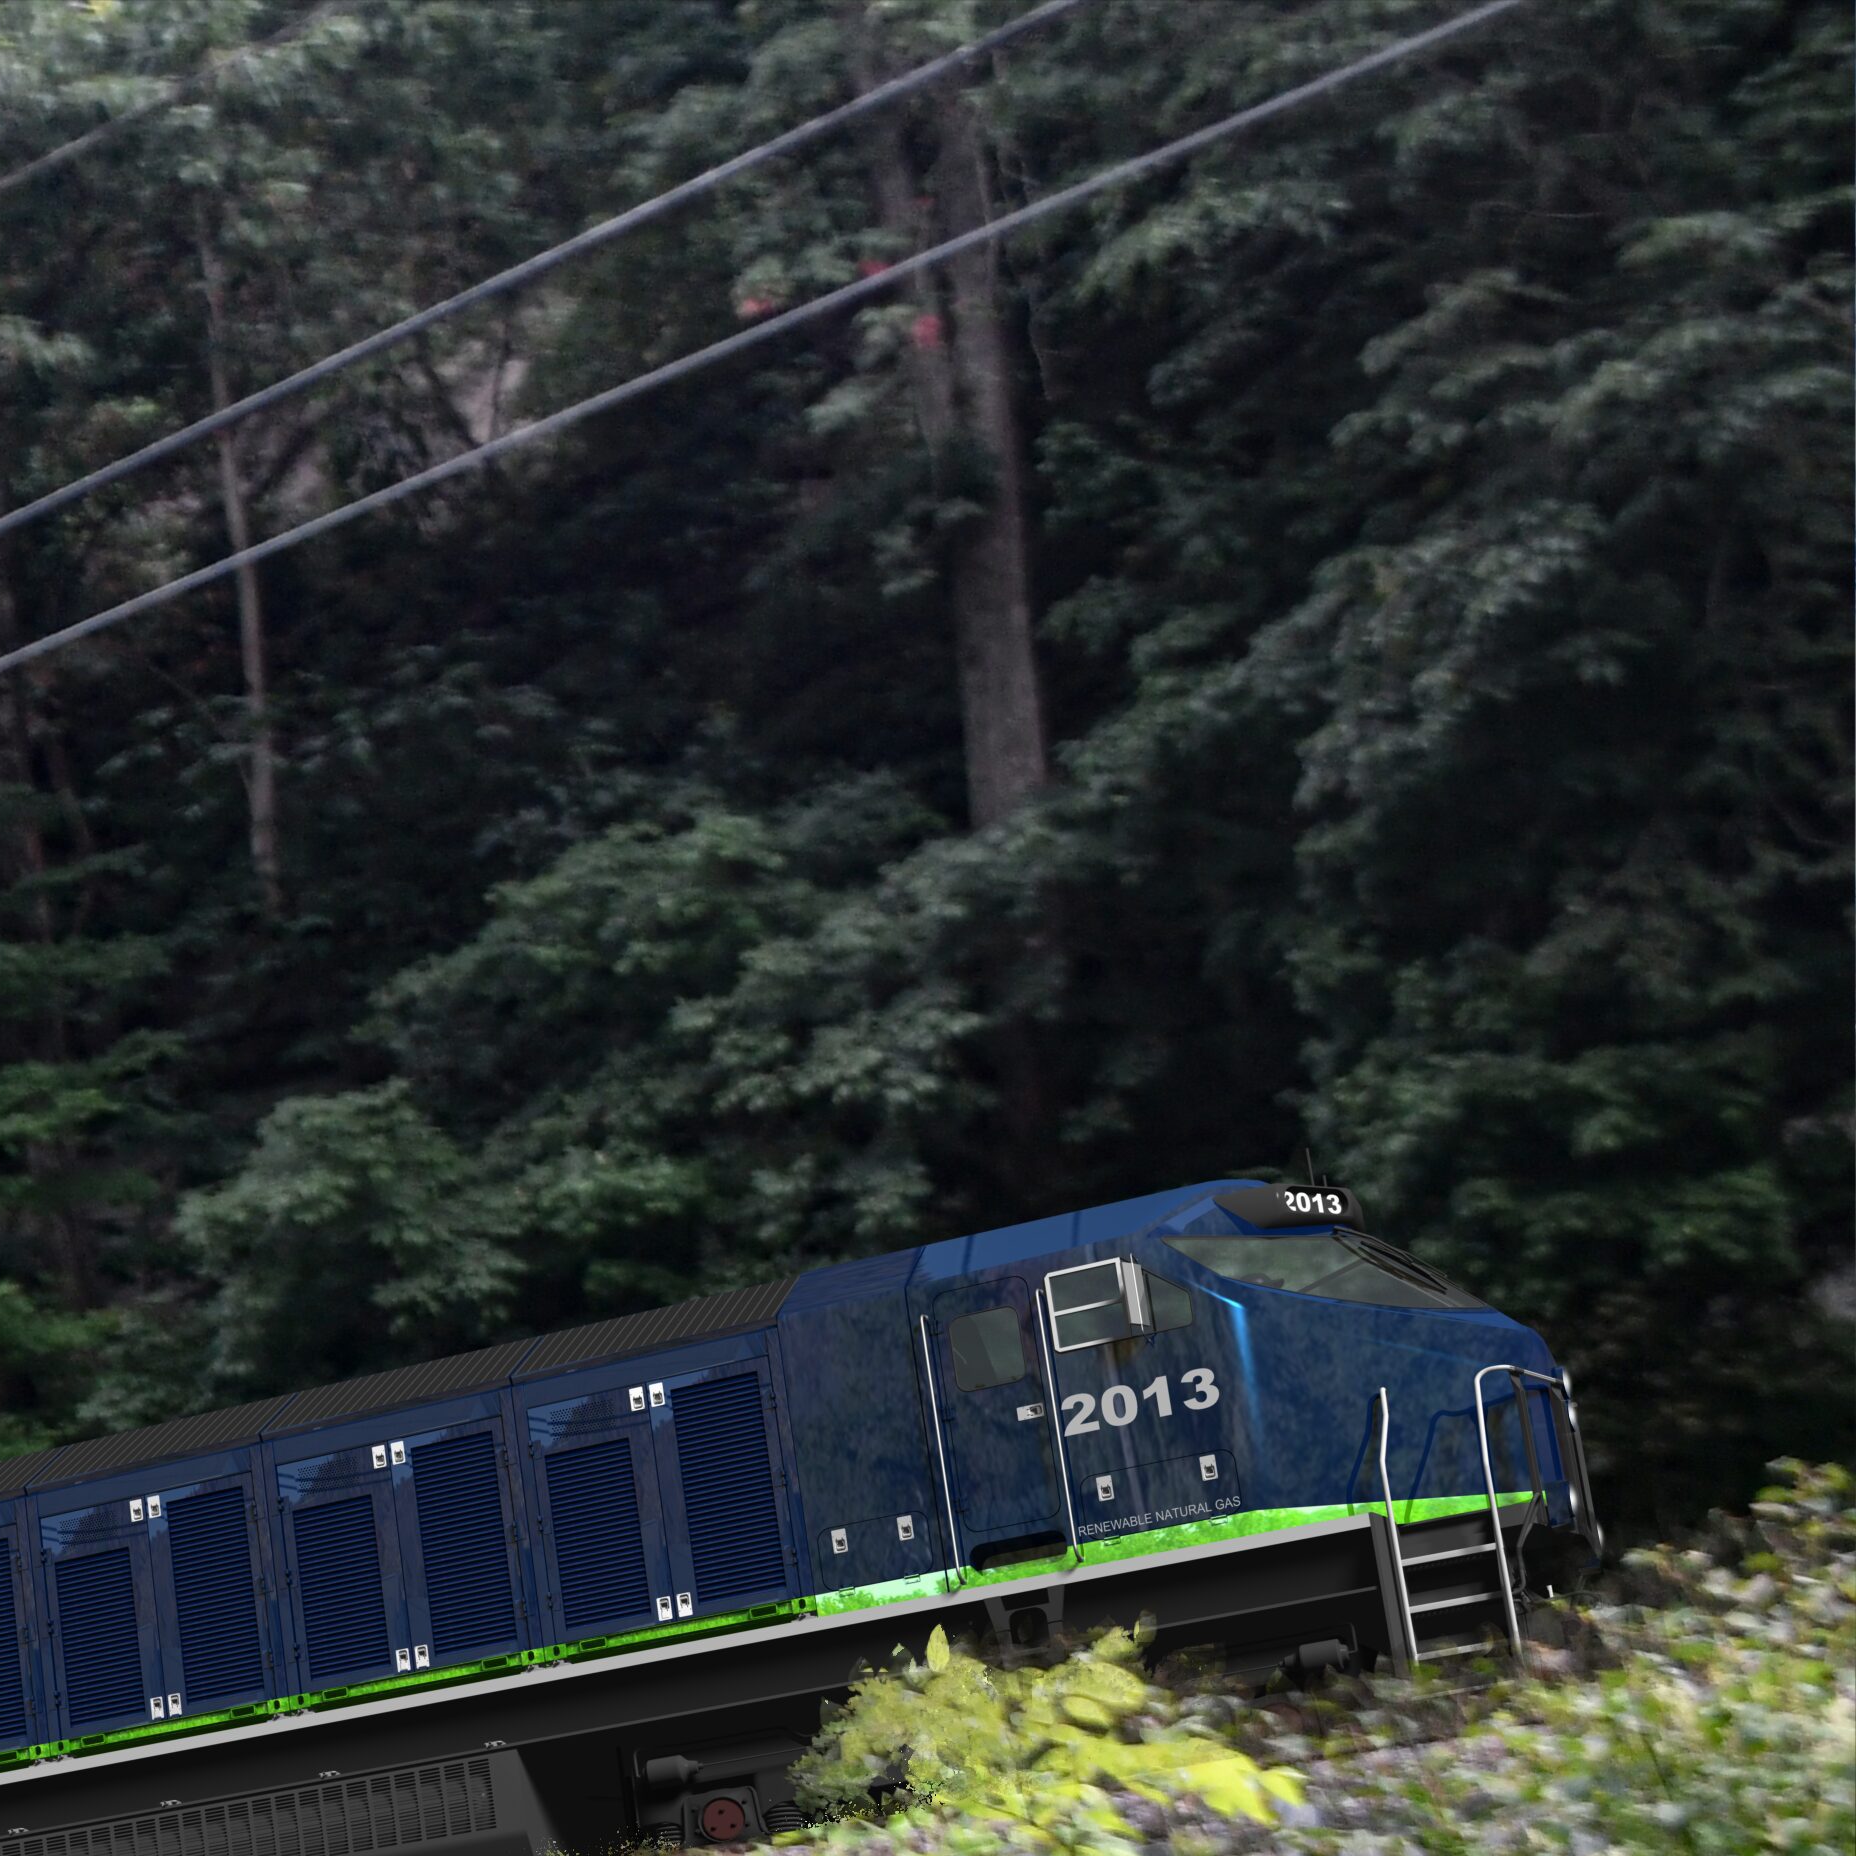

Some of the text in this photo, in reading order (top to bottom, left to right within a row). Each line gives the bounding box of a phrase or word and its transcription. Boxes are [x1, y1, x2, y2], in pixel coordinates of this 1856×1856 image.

[1284, 1191, 1342, 1215] 2013
[1061, 1367, 1220, 1437] 2013
[1078, 1496, 1241, 1537] RENEWABLE NATURAL GAS
